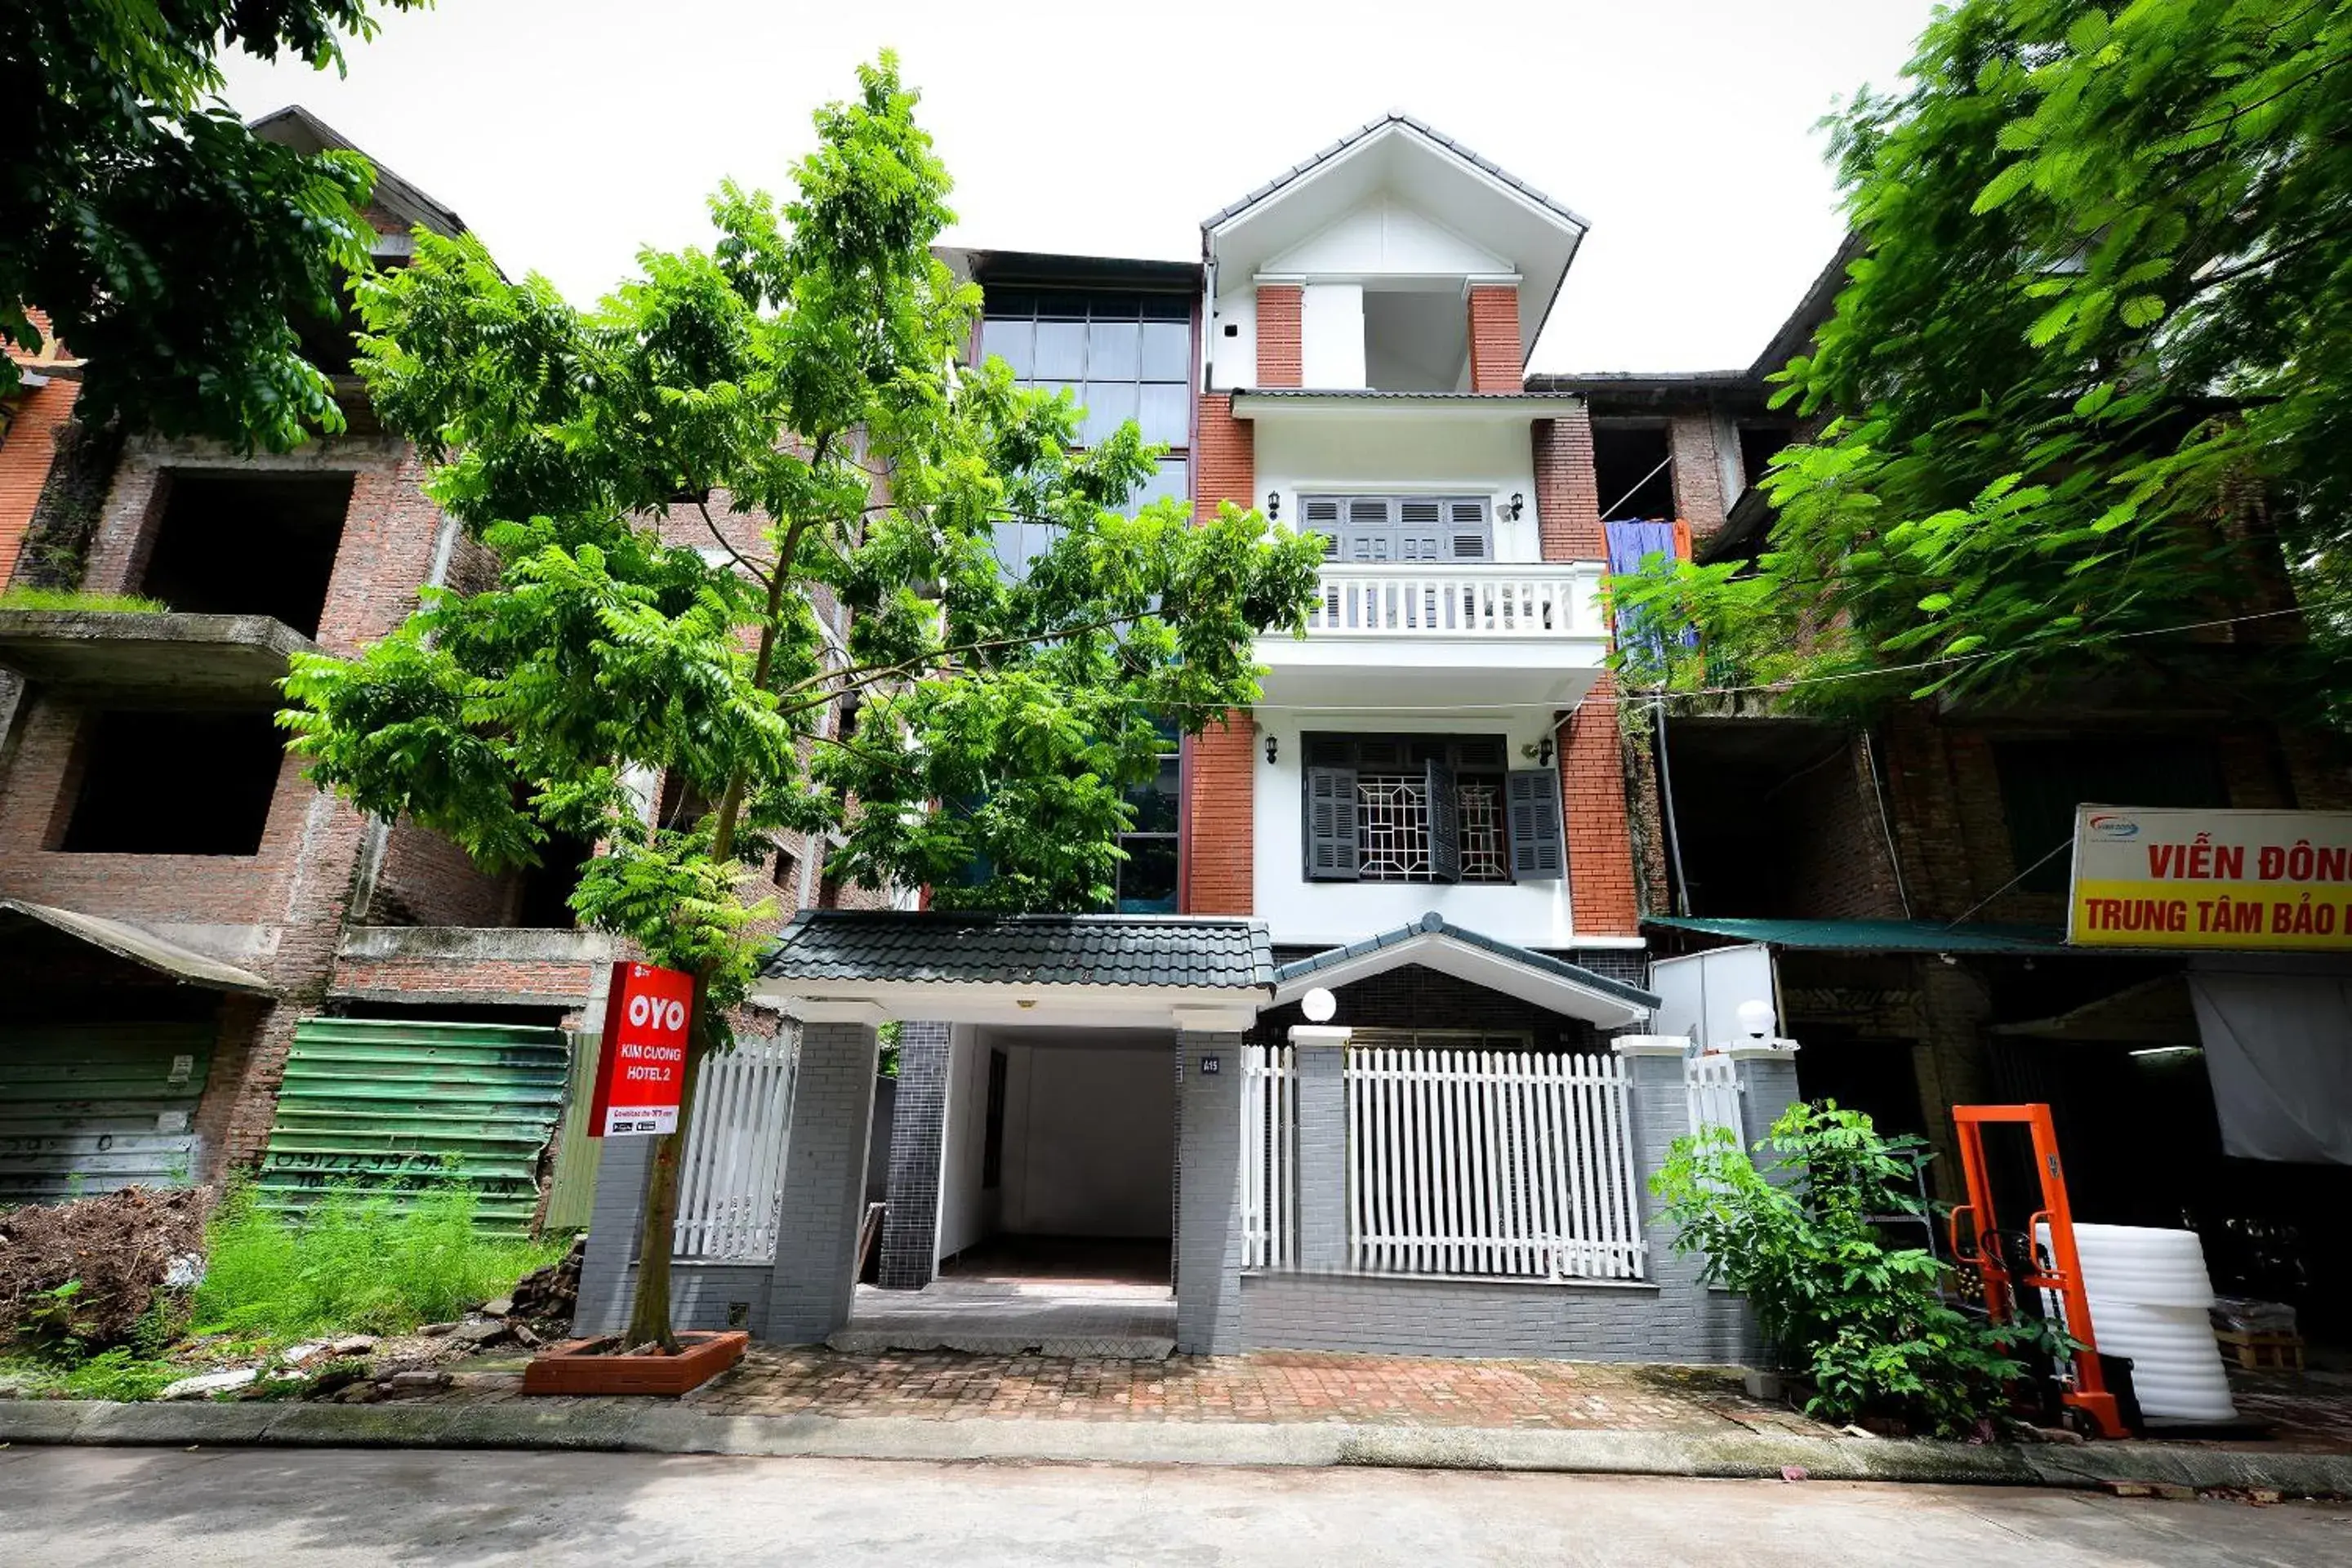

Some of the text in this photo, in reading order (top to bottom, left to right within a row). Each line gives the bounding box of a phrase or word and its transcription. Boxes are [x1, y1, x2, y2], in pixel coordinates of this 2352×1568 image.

[2148, 831, 2352, 881] VIỄN ĐÔN
[2085, 898, 2188, 933] TRUNG
[2197, 895, 2263, 933] TÂM
[2272, 893, 2335, 935] BẢO
[629, 994, 685, 1031] OYO
[621, 1044, 642, 1060] KIM
[627, 1067, 671, 1082] HOTEL 2
